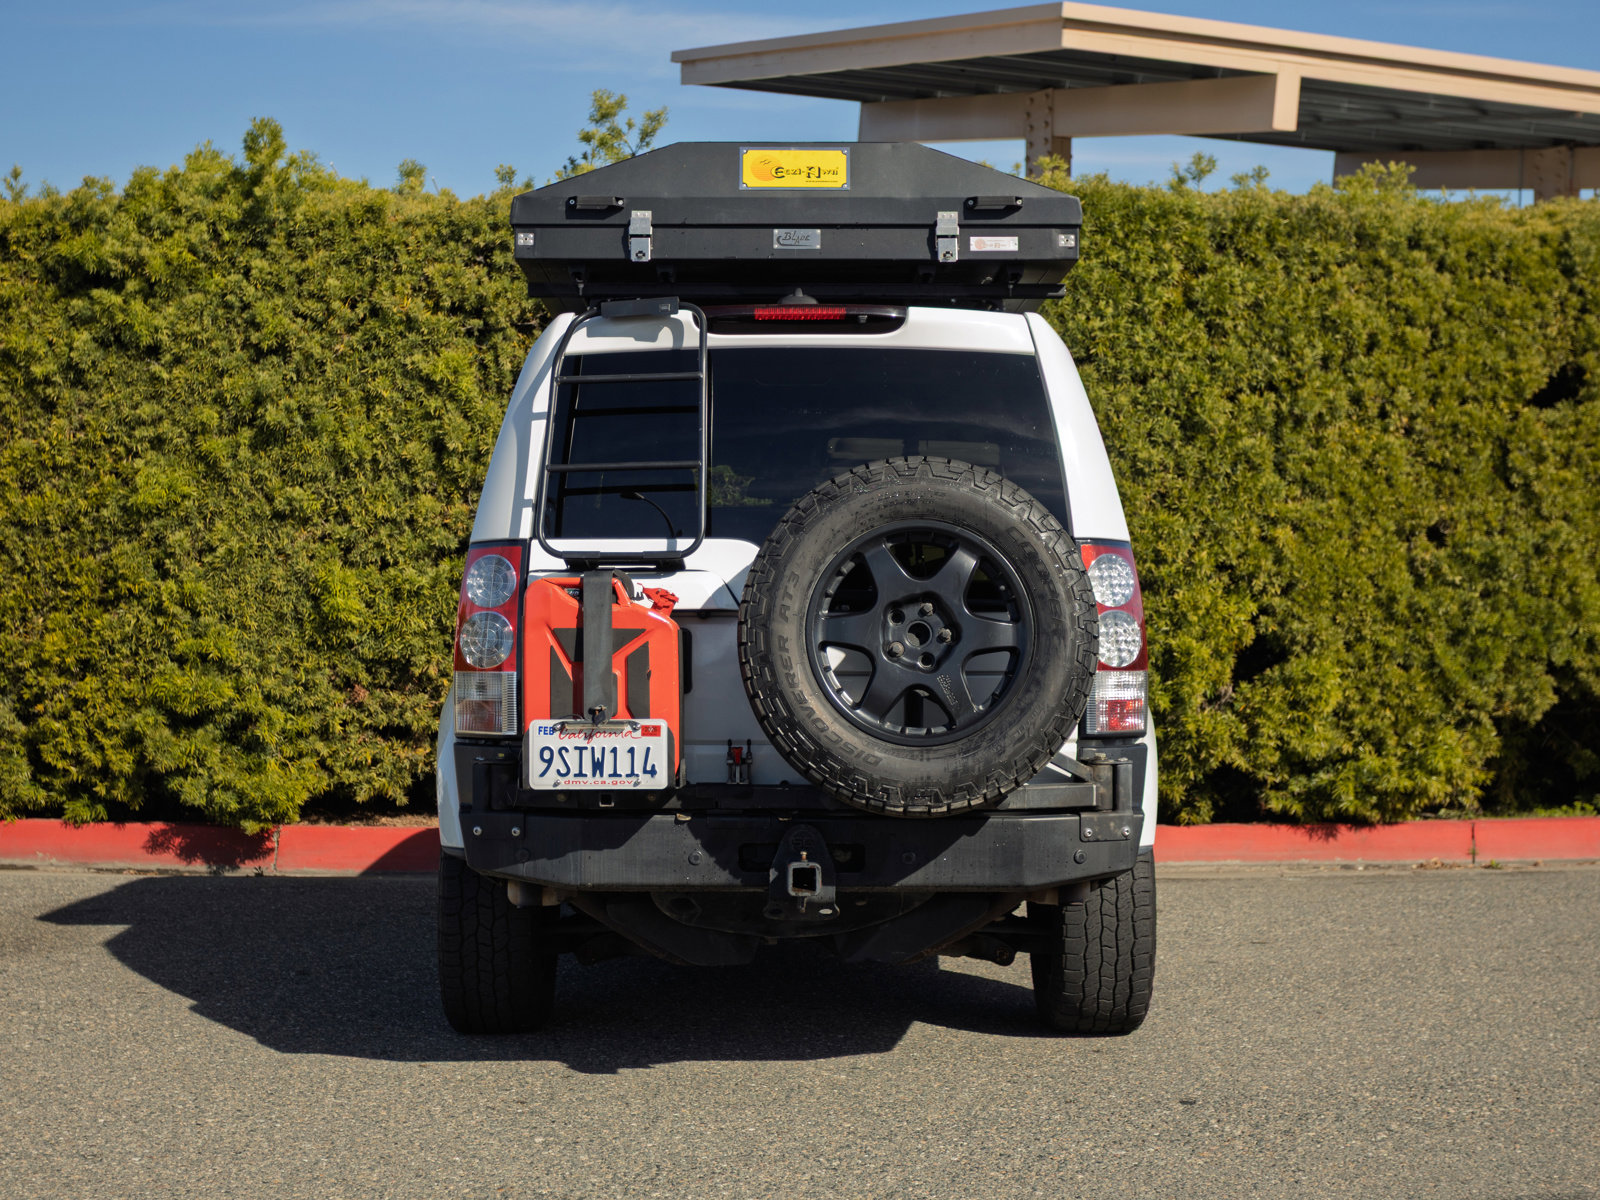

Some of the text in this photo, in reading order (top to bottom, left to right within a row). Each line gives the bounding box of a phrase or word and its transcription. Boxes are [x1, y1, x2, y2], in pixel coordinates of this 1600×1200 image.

[778, 571, 883, 768] DISCOVERER AT3
[538, 726, 555, 736] FEB
[558, 727, 642, 744] California
[539, 746, 659, 778] 9SIW114
